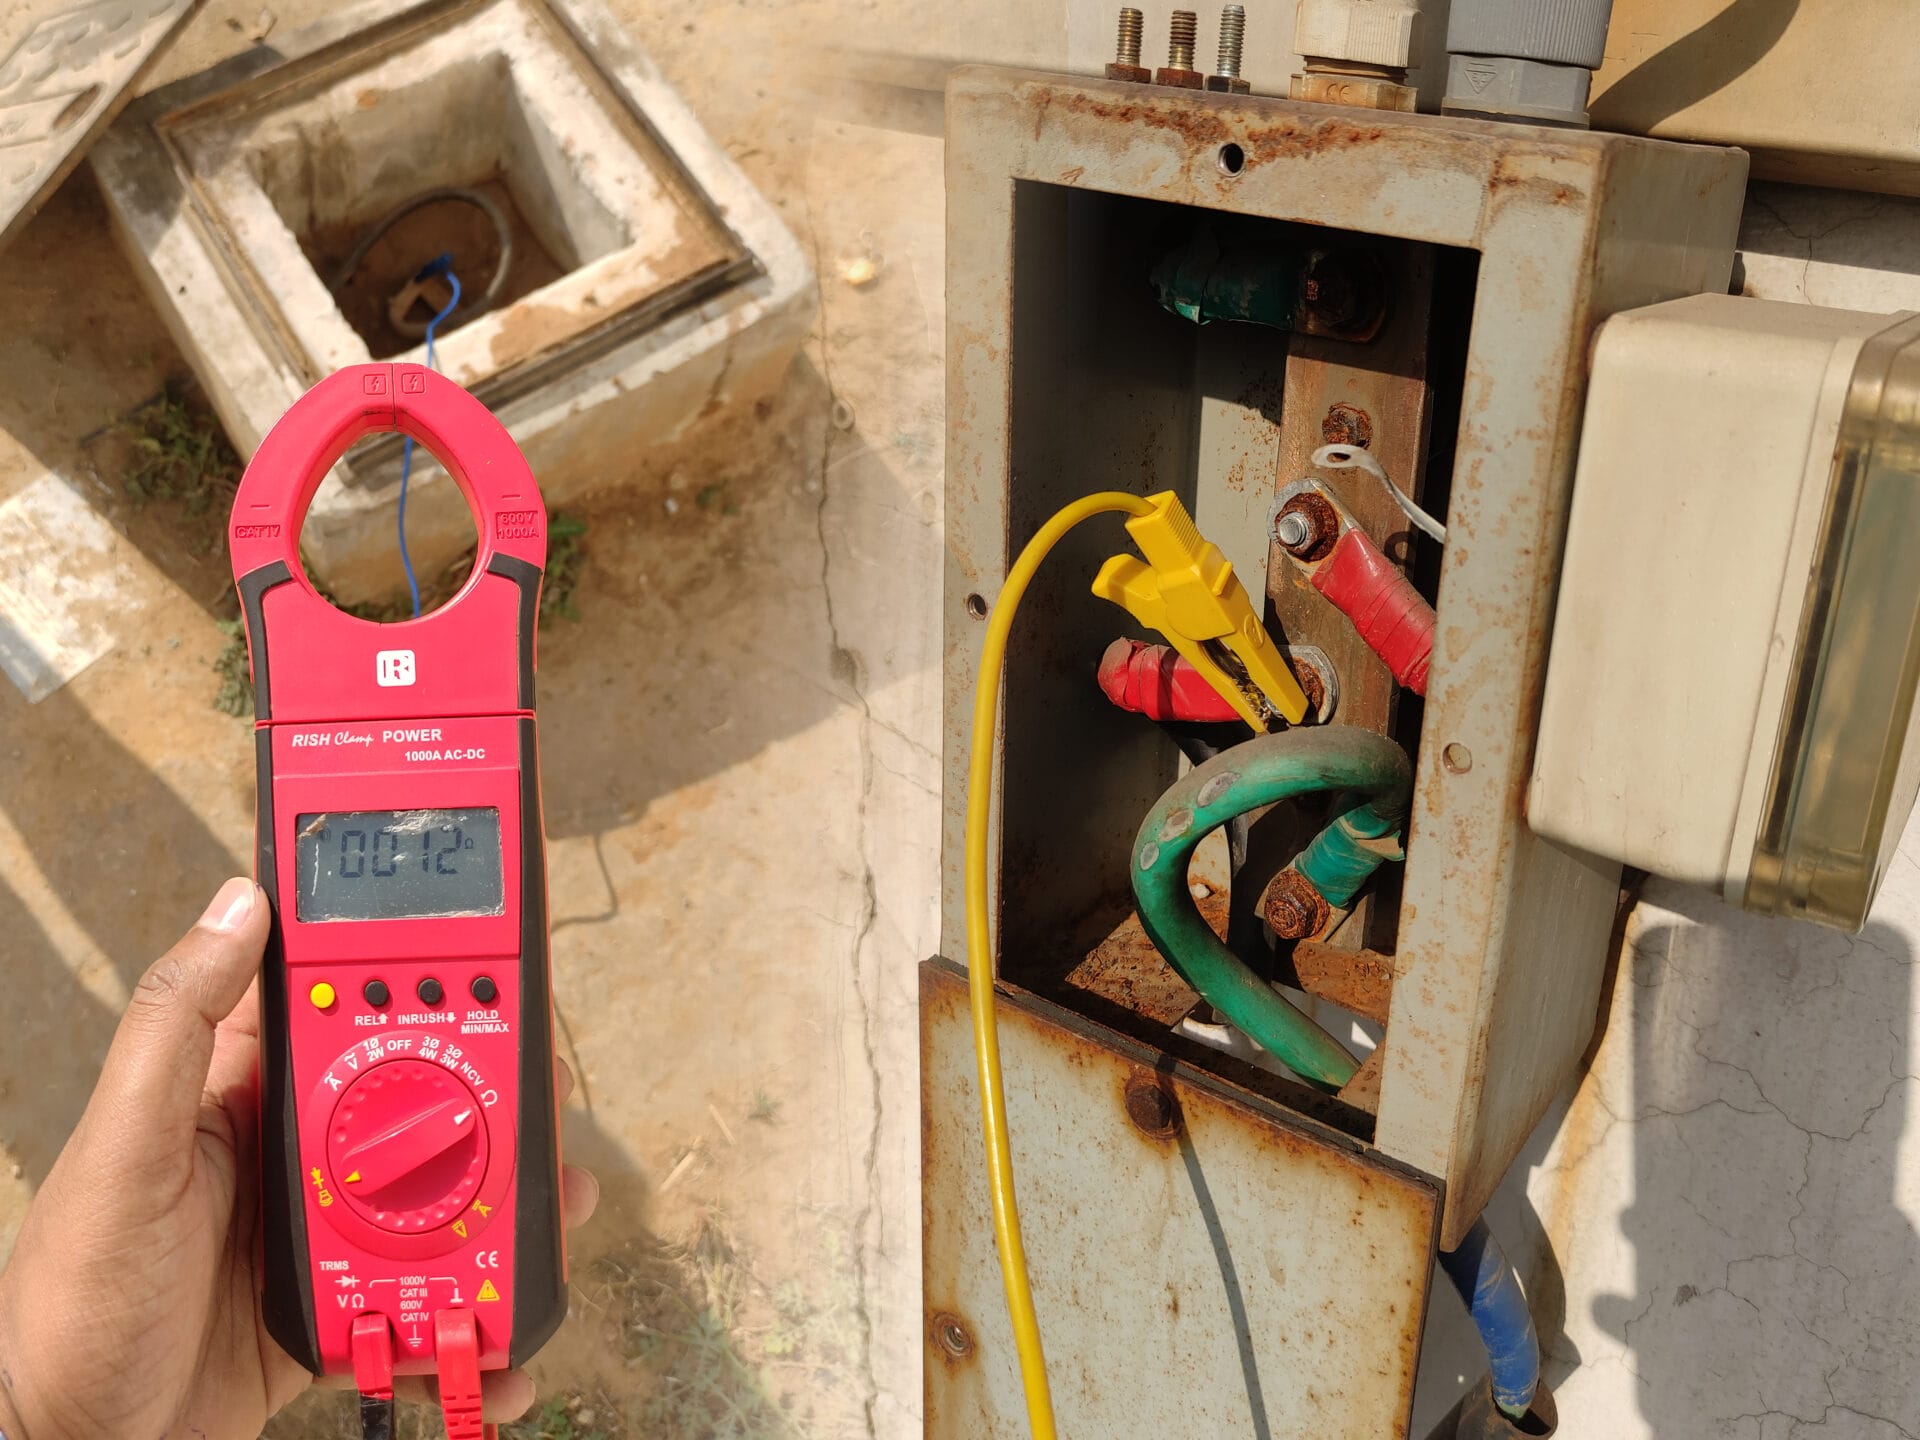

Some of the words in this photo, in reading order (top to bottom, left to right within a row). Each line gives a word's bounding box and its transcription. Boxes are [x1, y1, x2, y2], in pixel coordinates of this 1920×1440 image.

[500, 513, 535, 525] 600V
[498, 527, 540, 539] 1000A
[292, 733, 331, 747] RISH
[334, 731, 374, 748] Clamp
[382, 729, 442, 743] POWER
[405, 750, 442, 762] 1000A
[444, 748, 485, 760] AC-DC
[355, 1015, 380, 1026] REL
[398, 1014, 445, 1025] INRUSH
[467, 1010, 498, 1020] HOLD
[461, 1023, 509, 1034] MIN/MAX
[387, 1039, 412, 1051] OFF
[366, 1046, 384, 1062] 2W
[418, 1047, 438, 1060] 4W
[440, 1053, 458, 1070] 3W
[461, 1062, 484, 1087] NCV
[319, 1260, 349, 1271] TRMS
[476, 1250, 499, 1269] CE
[400, 1276, 426, 1286] 1000V
[400, 1288, 418, 1298] CAT
[420, 1288, 428, 1298] III
[336, 1294, 349, 1309] V
[401, 1300, 423, 1310] 600V
[401, 1312, 418, 1323] CAT
[420, 1312, 429, 1322] IV
